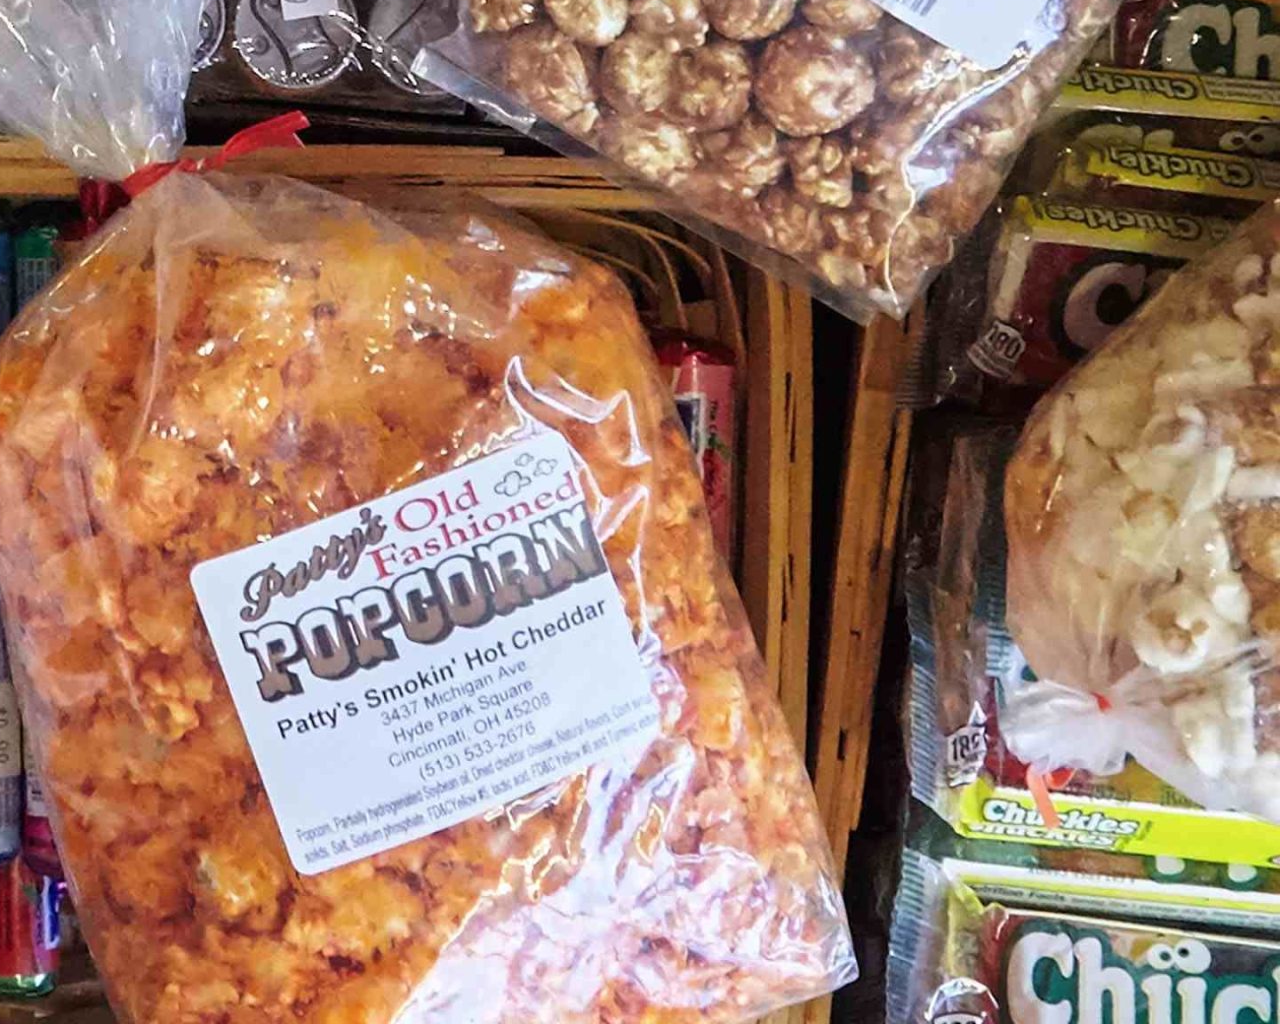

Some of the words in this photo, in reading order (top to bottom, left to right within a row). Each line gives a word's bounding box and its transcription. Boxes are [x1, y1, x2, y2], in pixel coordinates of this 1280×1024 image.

[365, 472, 582, 581] Fashioned
[393, 479, 480, 533] Old
[239, 501, 608, 703] POPCORN
[240, 507, 388, 623] Patty's
[276, 700, 359, 740] Patty's
[363, 656, 456, 709] Smokin'
[463, 640, 508, 671] Hot
[510, 599, 605, 650] Cheddar
[379, 698, 418, 727] 3437
[422, 673, 494, 710] Michigan
[497, 659, 527, 680] Ave
[387, 727, 471, 768] Cincinnati,
[472, 712, 501, 735] OH
[503, 690, 551, 721] 45208
[391, 719, 434, 745] Hyde
[436, 703, 475, 727] Park
[476, 679, 534, 711] Square
[418, 752, 461, 782] (513)
[462, 719, 536, 762] 533-2676
